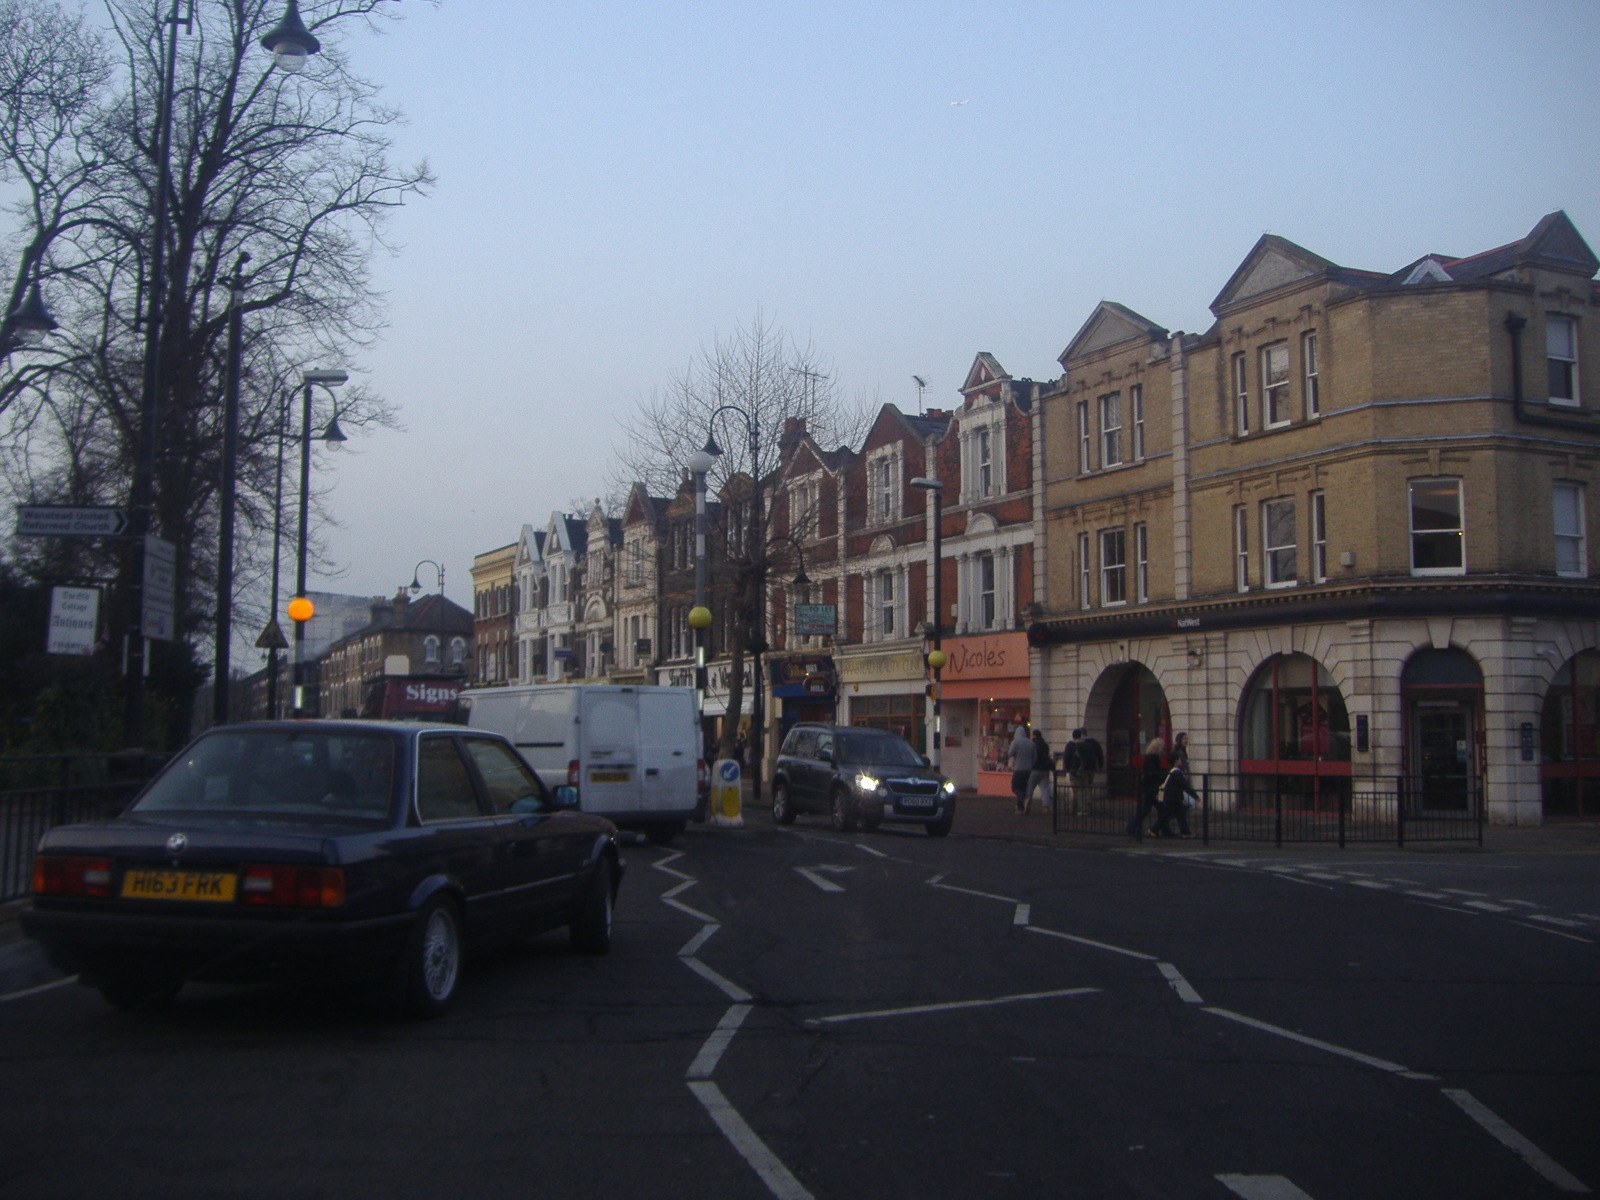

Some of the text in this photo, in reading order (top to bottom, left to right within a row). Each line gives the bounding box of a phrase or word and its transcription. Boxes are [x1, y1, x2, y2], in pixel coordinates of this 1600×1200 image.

[76, 511, 109, 520] United
[22, 521, 110, 531] Reformed Church
[1177, 618, 1201, 628] NatWest
[949, 639, 1006, 673] Nicole's
[405, 683, 459, 703] Signs
